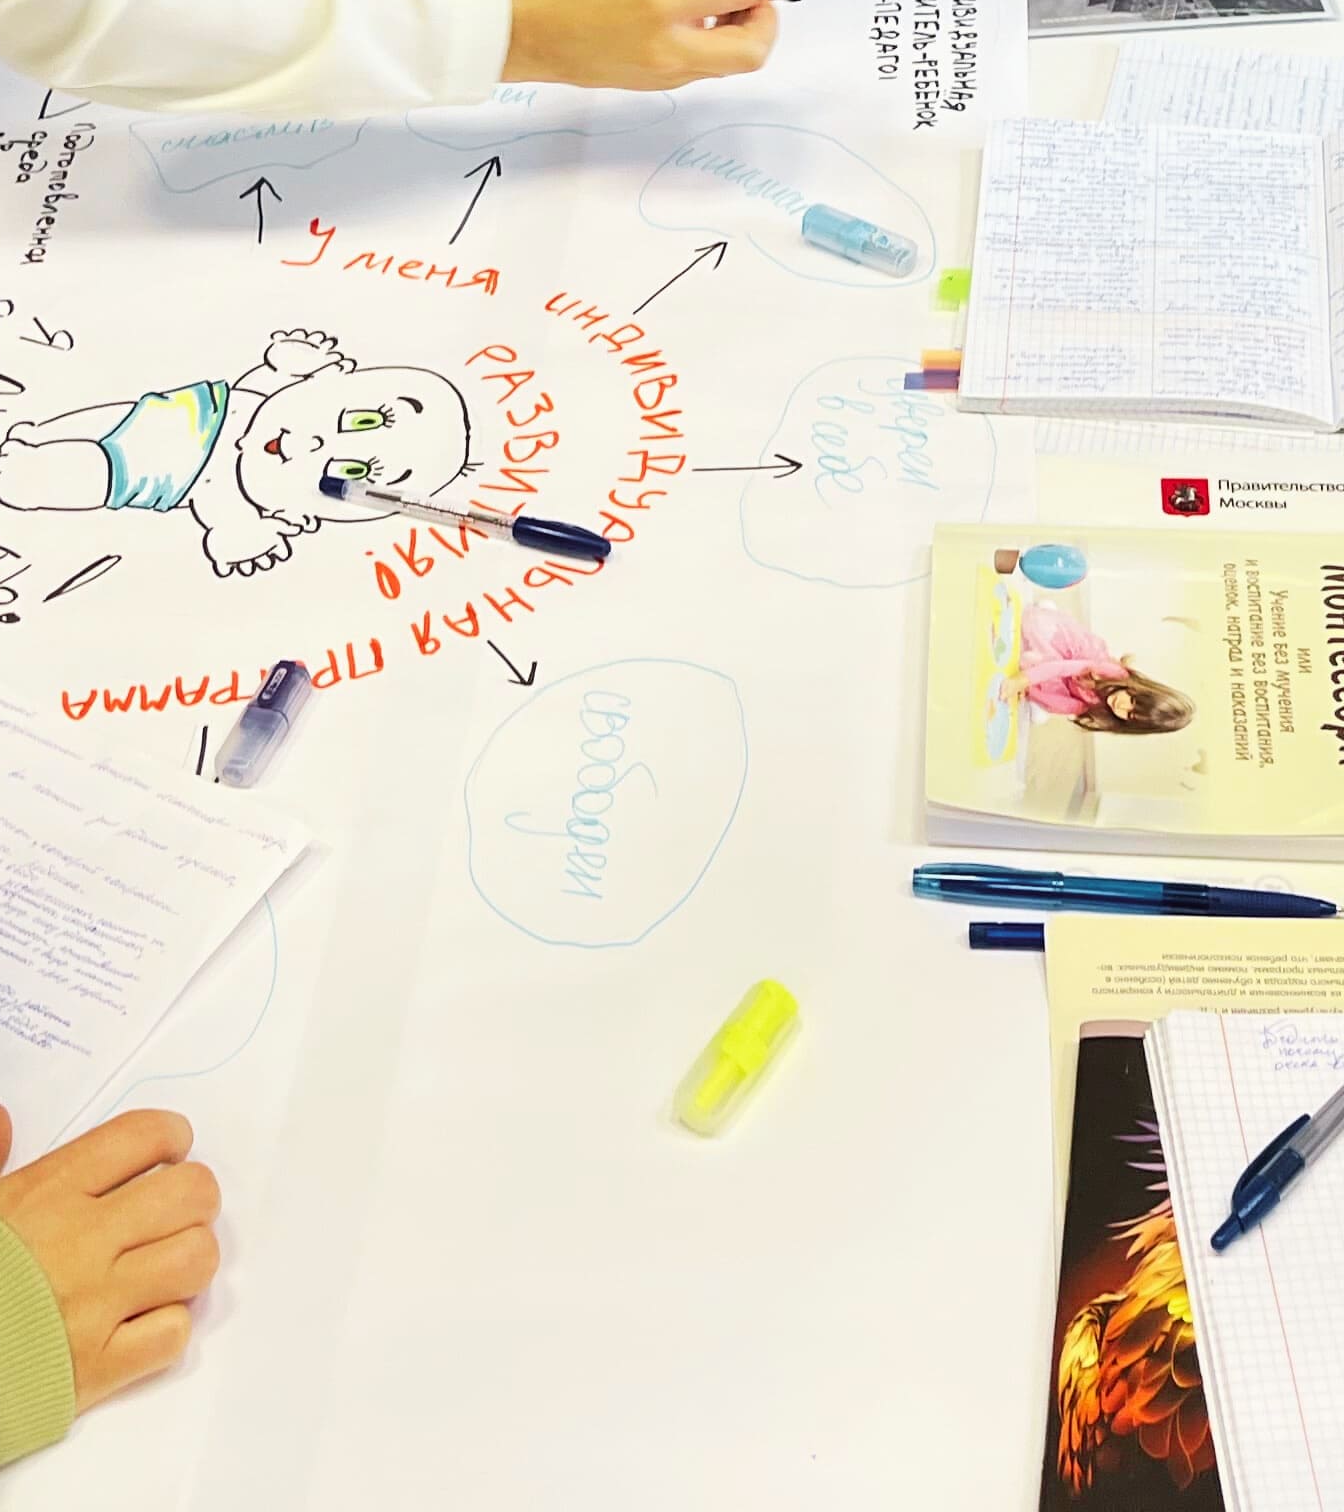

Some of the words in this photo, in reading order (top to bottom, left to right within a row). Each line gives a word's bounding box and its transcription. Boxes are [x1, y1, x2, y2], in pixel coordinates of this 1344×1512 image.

[8, 131, 47, 184] среда
[281, 218, 336, 267] У
[344, 250, 501, 297] меня
[19, 316, 74, 351] Я
[1219, 496, 1287, 510] Москвы
[1245, 558, 1258, 567] и
[1246, 569, 1266, 650] воспитание
[1269, 589, 1289, 638] Учение
[1222, 615, 1244, 666] наград
[1251, 651, 1267, 675] без
[1273, 642, 1288, 665] без
[1297, 647, 1312, 674] или
[61, 637, 385, 721] ПРРАММА
[1230, 668, 1244, 678] и
[1230, 680, 1254, 762] наказаний
[1270, 669, 1295, 734] мучения
